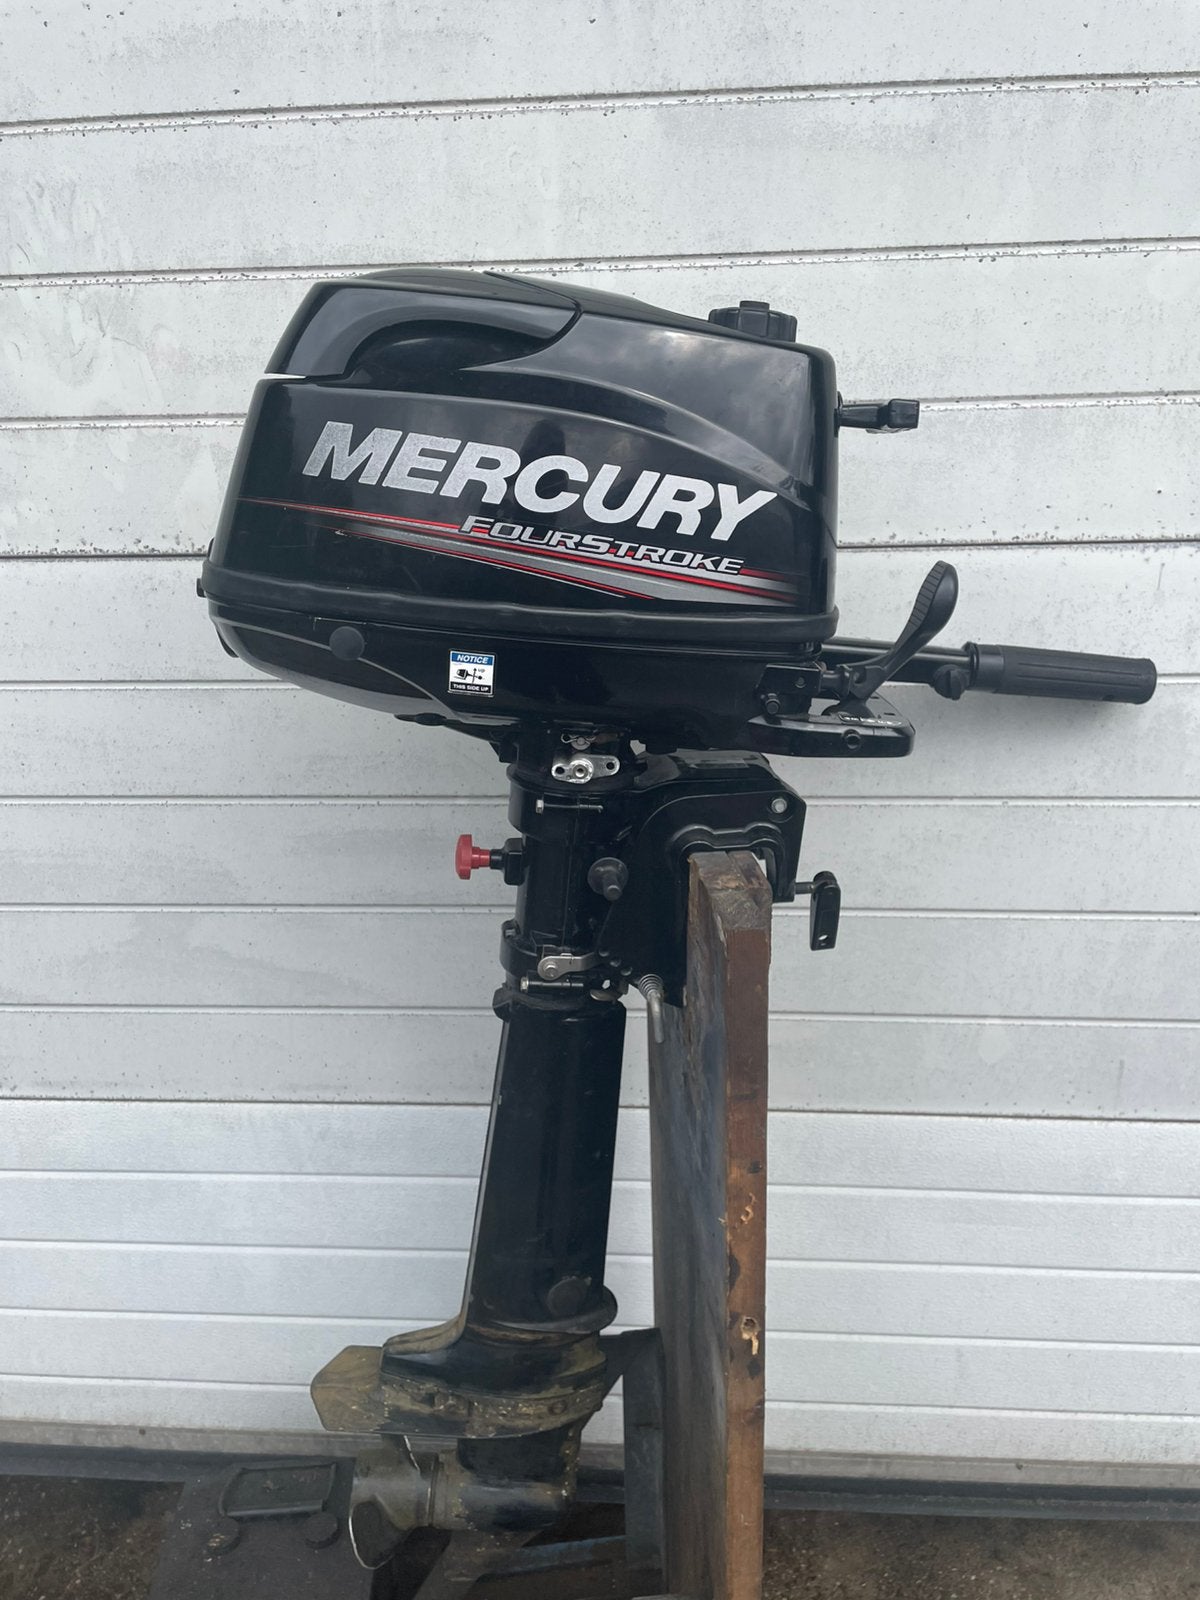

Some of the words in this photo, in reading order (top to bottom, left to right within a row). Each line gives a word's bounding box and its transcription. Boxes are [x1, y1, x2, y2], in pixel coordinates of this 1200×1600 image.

[302, 421, 777, 542] MERCURY
[459, 515, 744, 575] FOURSTROKE
[456, 654, 489, 664] NOTICE
